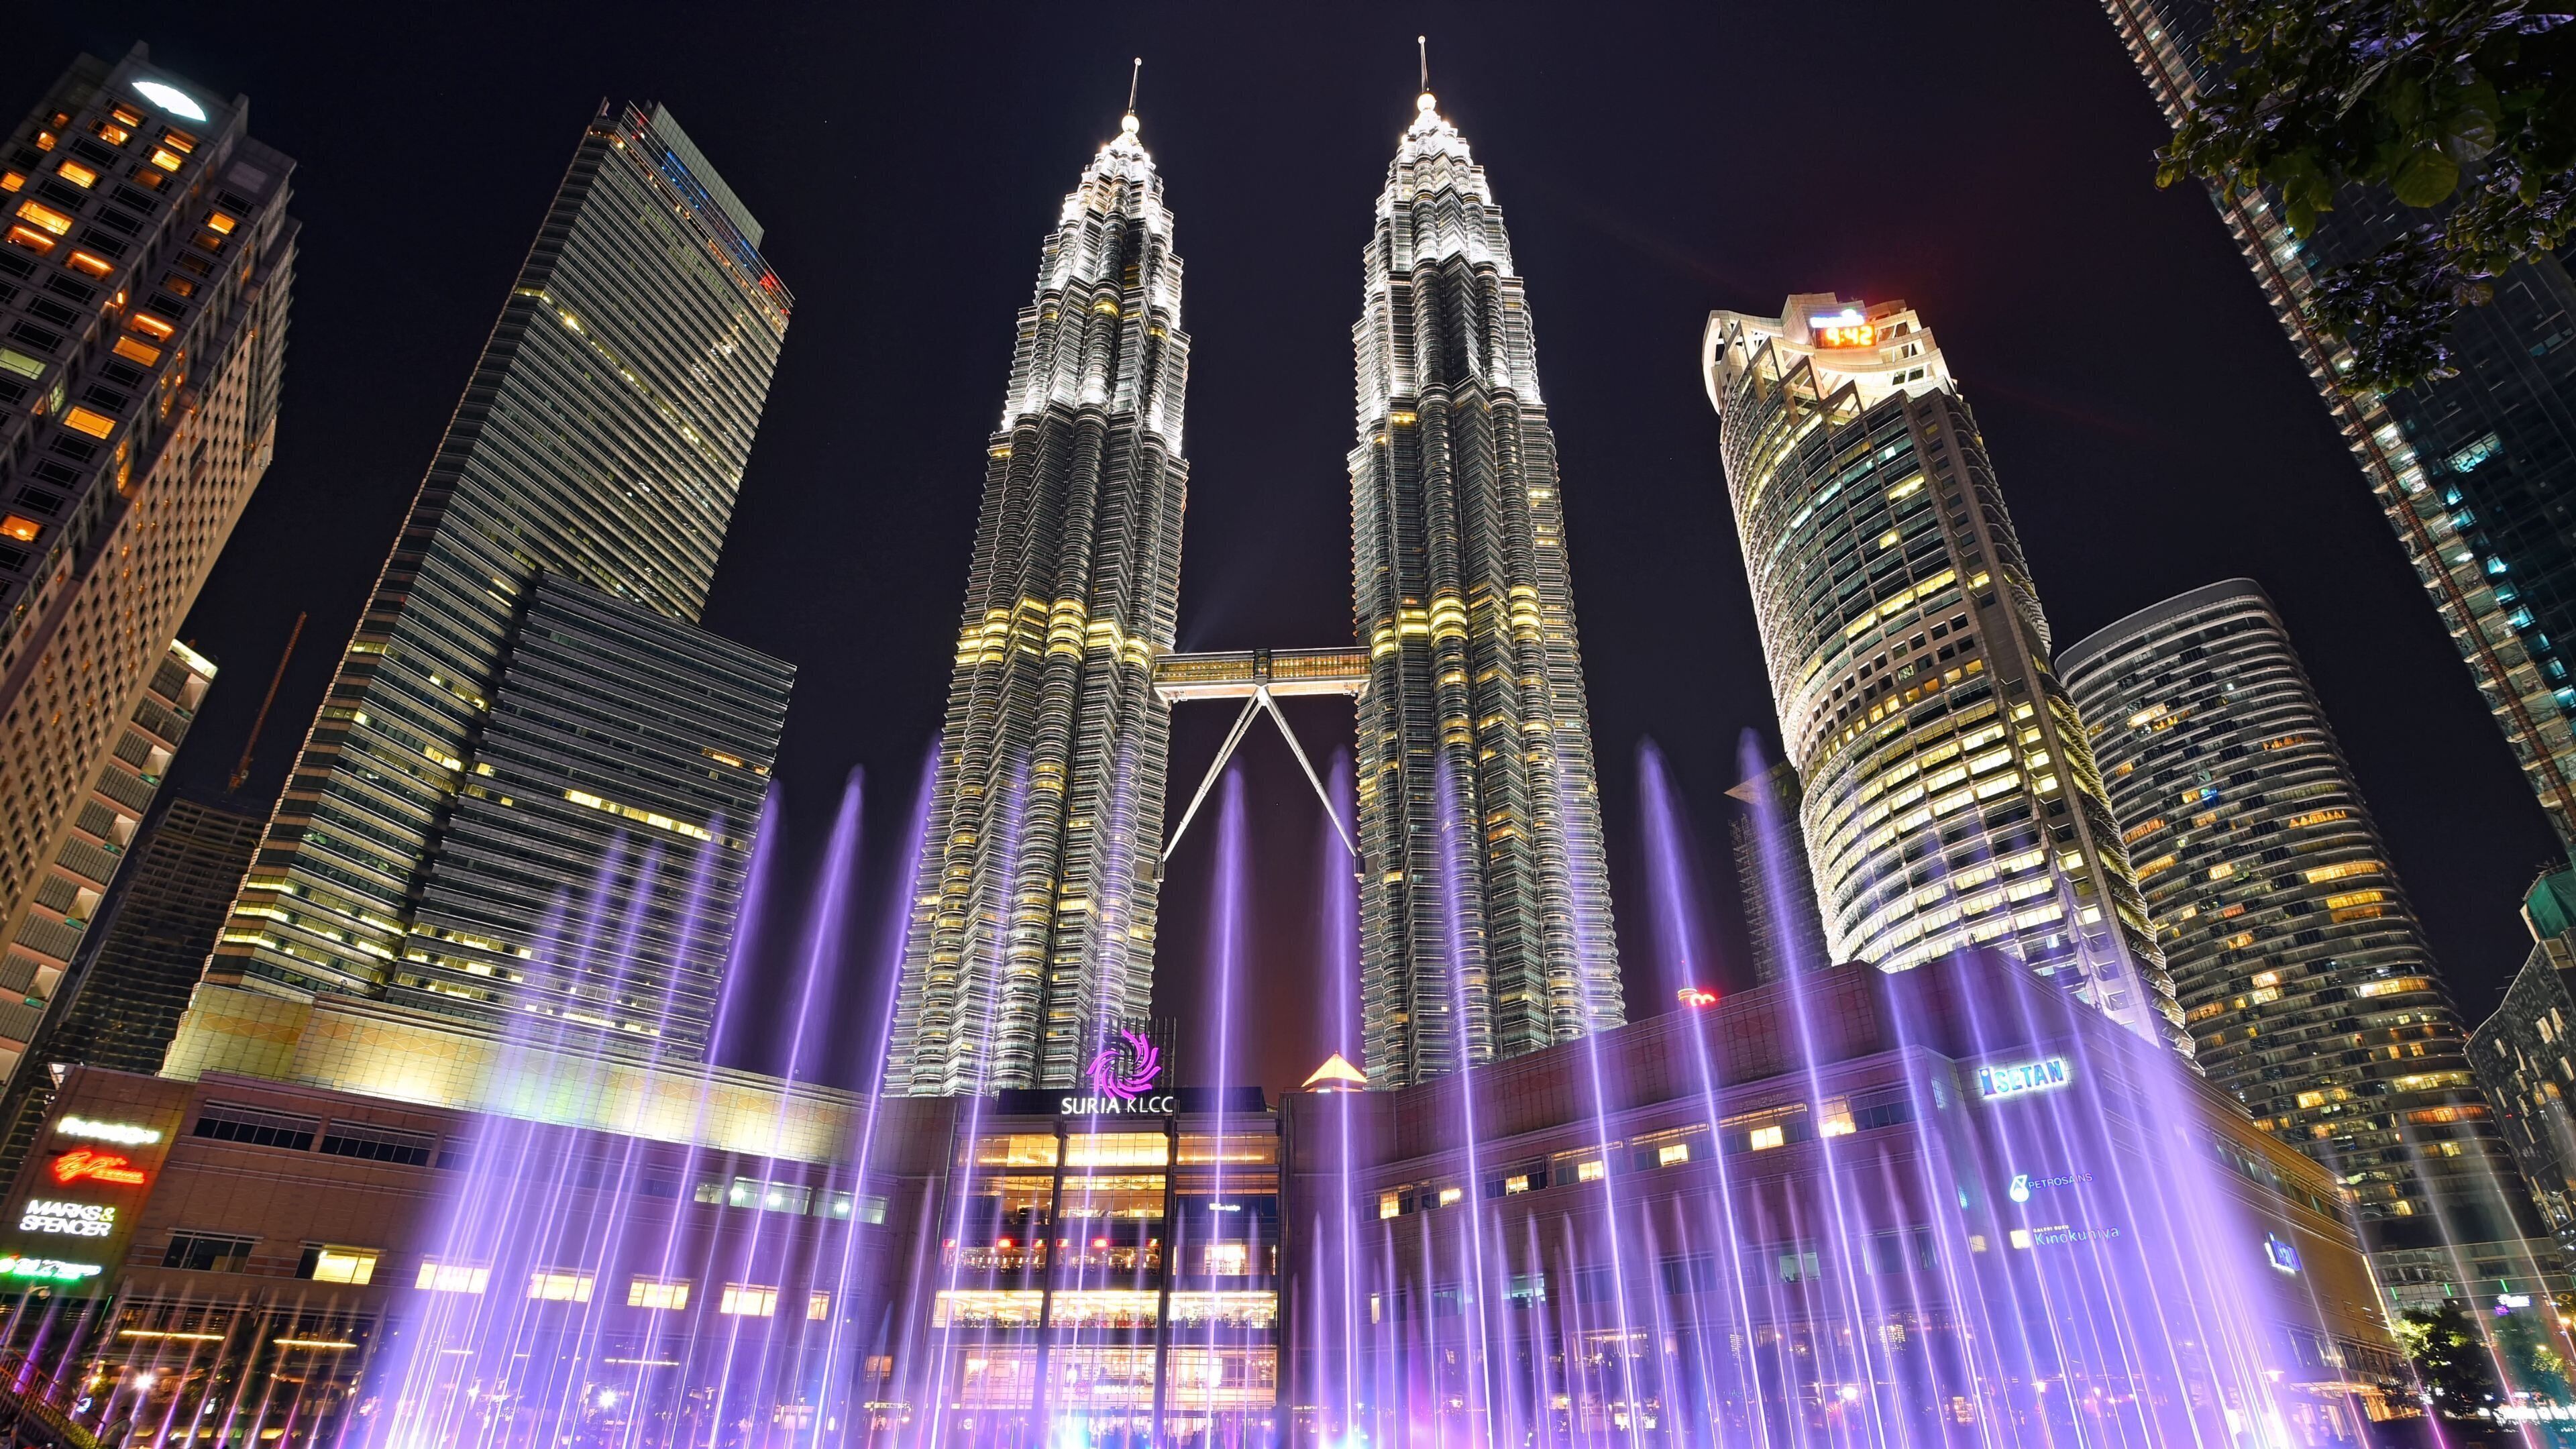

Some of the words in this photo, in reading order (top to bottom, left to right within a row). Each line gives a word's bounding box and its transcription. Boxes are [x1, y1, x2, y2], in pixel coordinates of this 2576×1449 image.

[1826, 325, 1872, 346] 9:42
[1061, 1097, 1120, 1114] SURIA
[1127, 1096, 1173, 1113] KLCC
[2028, 1173, 2093, 1189] PETROSAINS
[25, 1199, 103, 1221] MARKS
[99, 1207, 115, 1222] &
[19, 1215, 112, 1236] SPENCER
[2034, 1227, 2120, 1246] Kinokuniya
